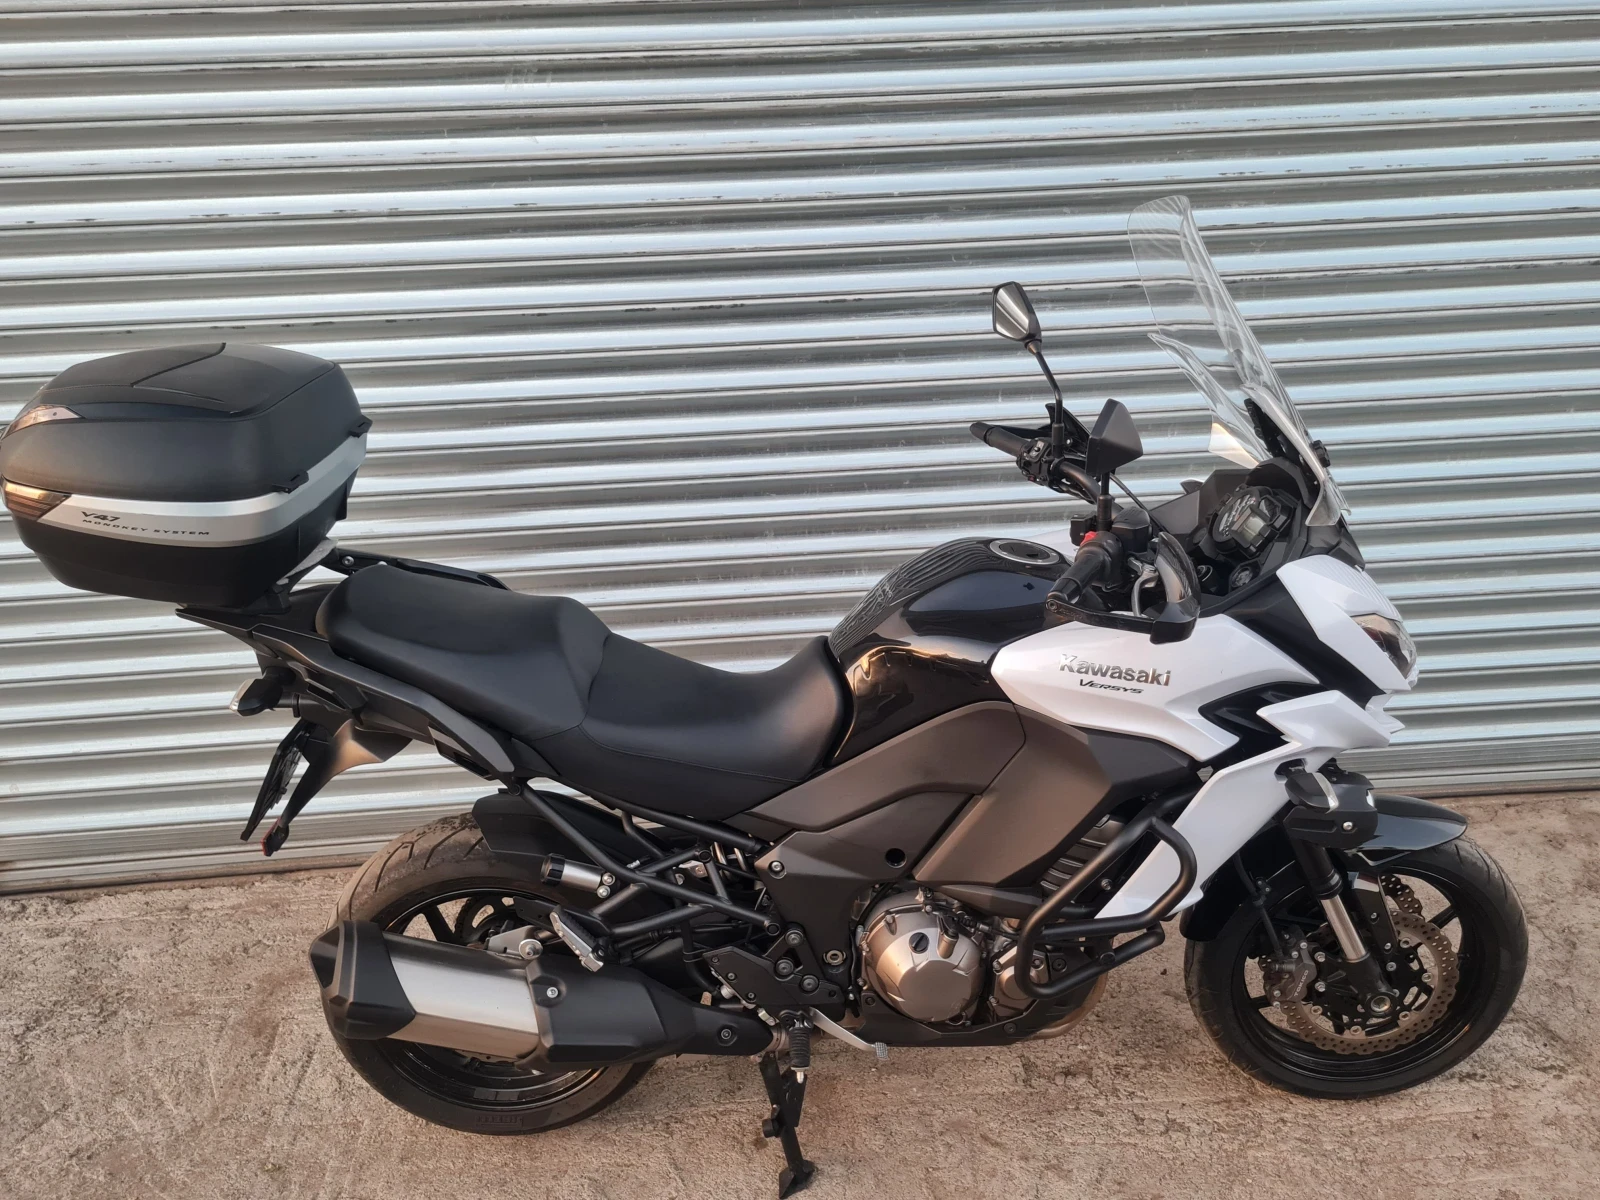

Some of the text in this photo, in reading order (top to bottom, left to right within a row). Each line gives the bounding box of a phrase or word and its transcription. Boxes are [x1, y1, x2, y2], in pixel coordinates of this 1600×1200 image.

[81, 511, 120, 522] V47
[83, 519, 148, 532] MONOKEY
[1059, 653, 1172, 687] Kawasaki
[1079, 678, 1145, 694] VERSYS
[1293, 969, 1309, 997] TOKICO
